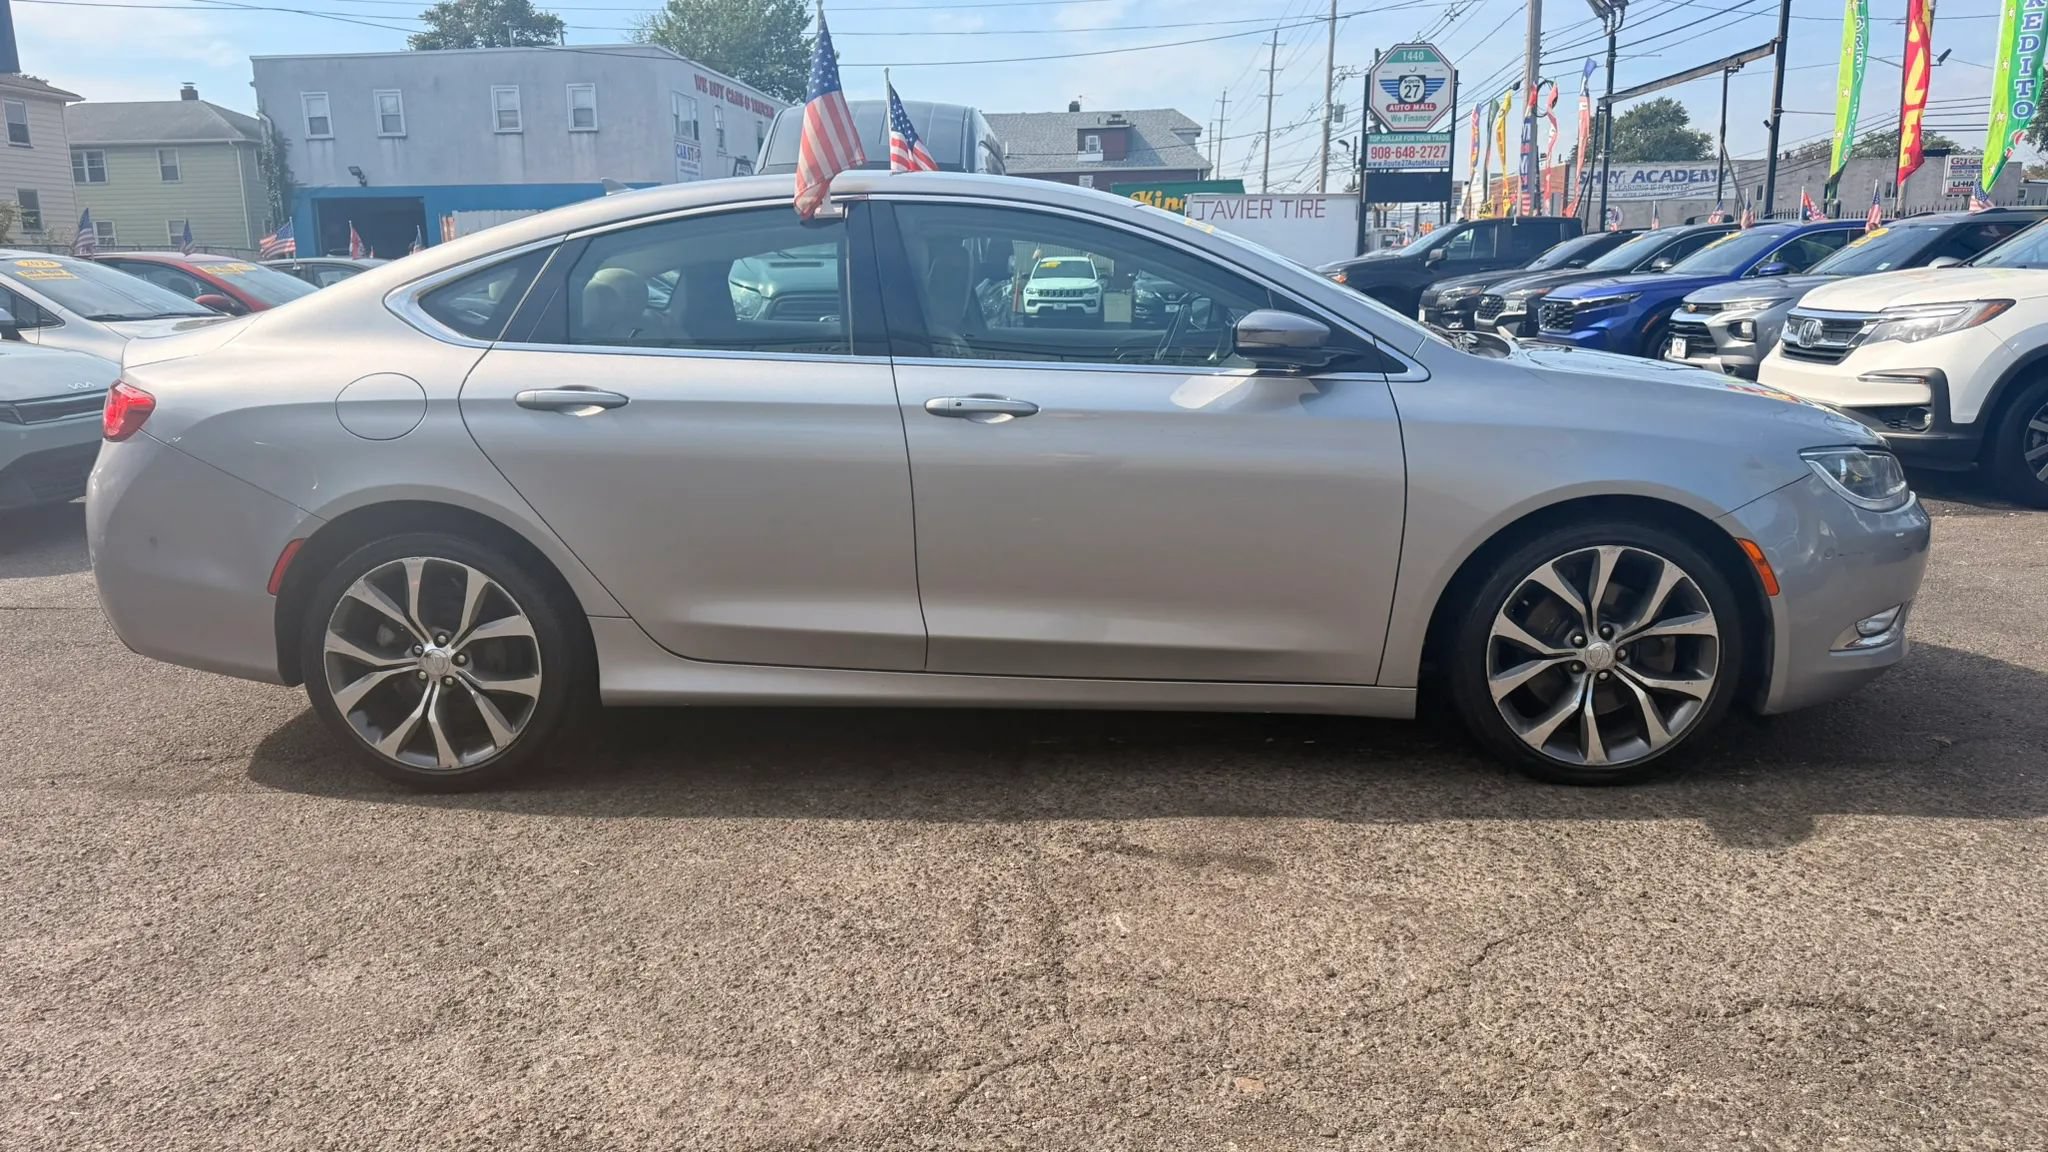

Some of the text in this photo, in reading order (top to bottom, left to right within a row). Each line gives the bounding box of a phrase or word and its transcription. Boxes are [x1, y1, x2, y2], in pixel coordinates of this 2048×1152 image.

[1402, 51, 1424, 61] 1440
[1404, 85, 1420, 99] 27
[1412, 103, 1434, 111] MALL
[1391, 114, 1432, 122] We Finance
[1371, 145, 1447, 159] 908-648-2727
[1631, 168, 1729, 184] ACADEMY
[1194, 199, 1326, 221] JAVIER TIRE
